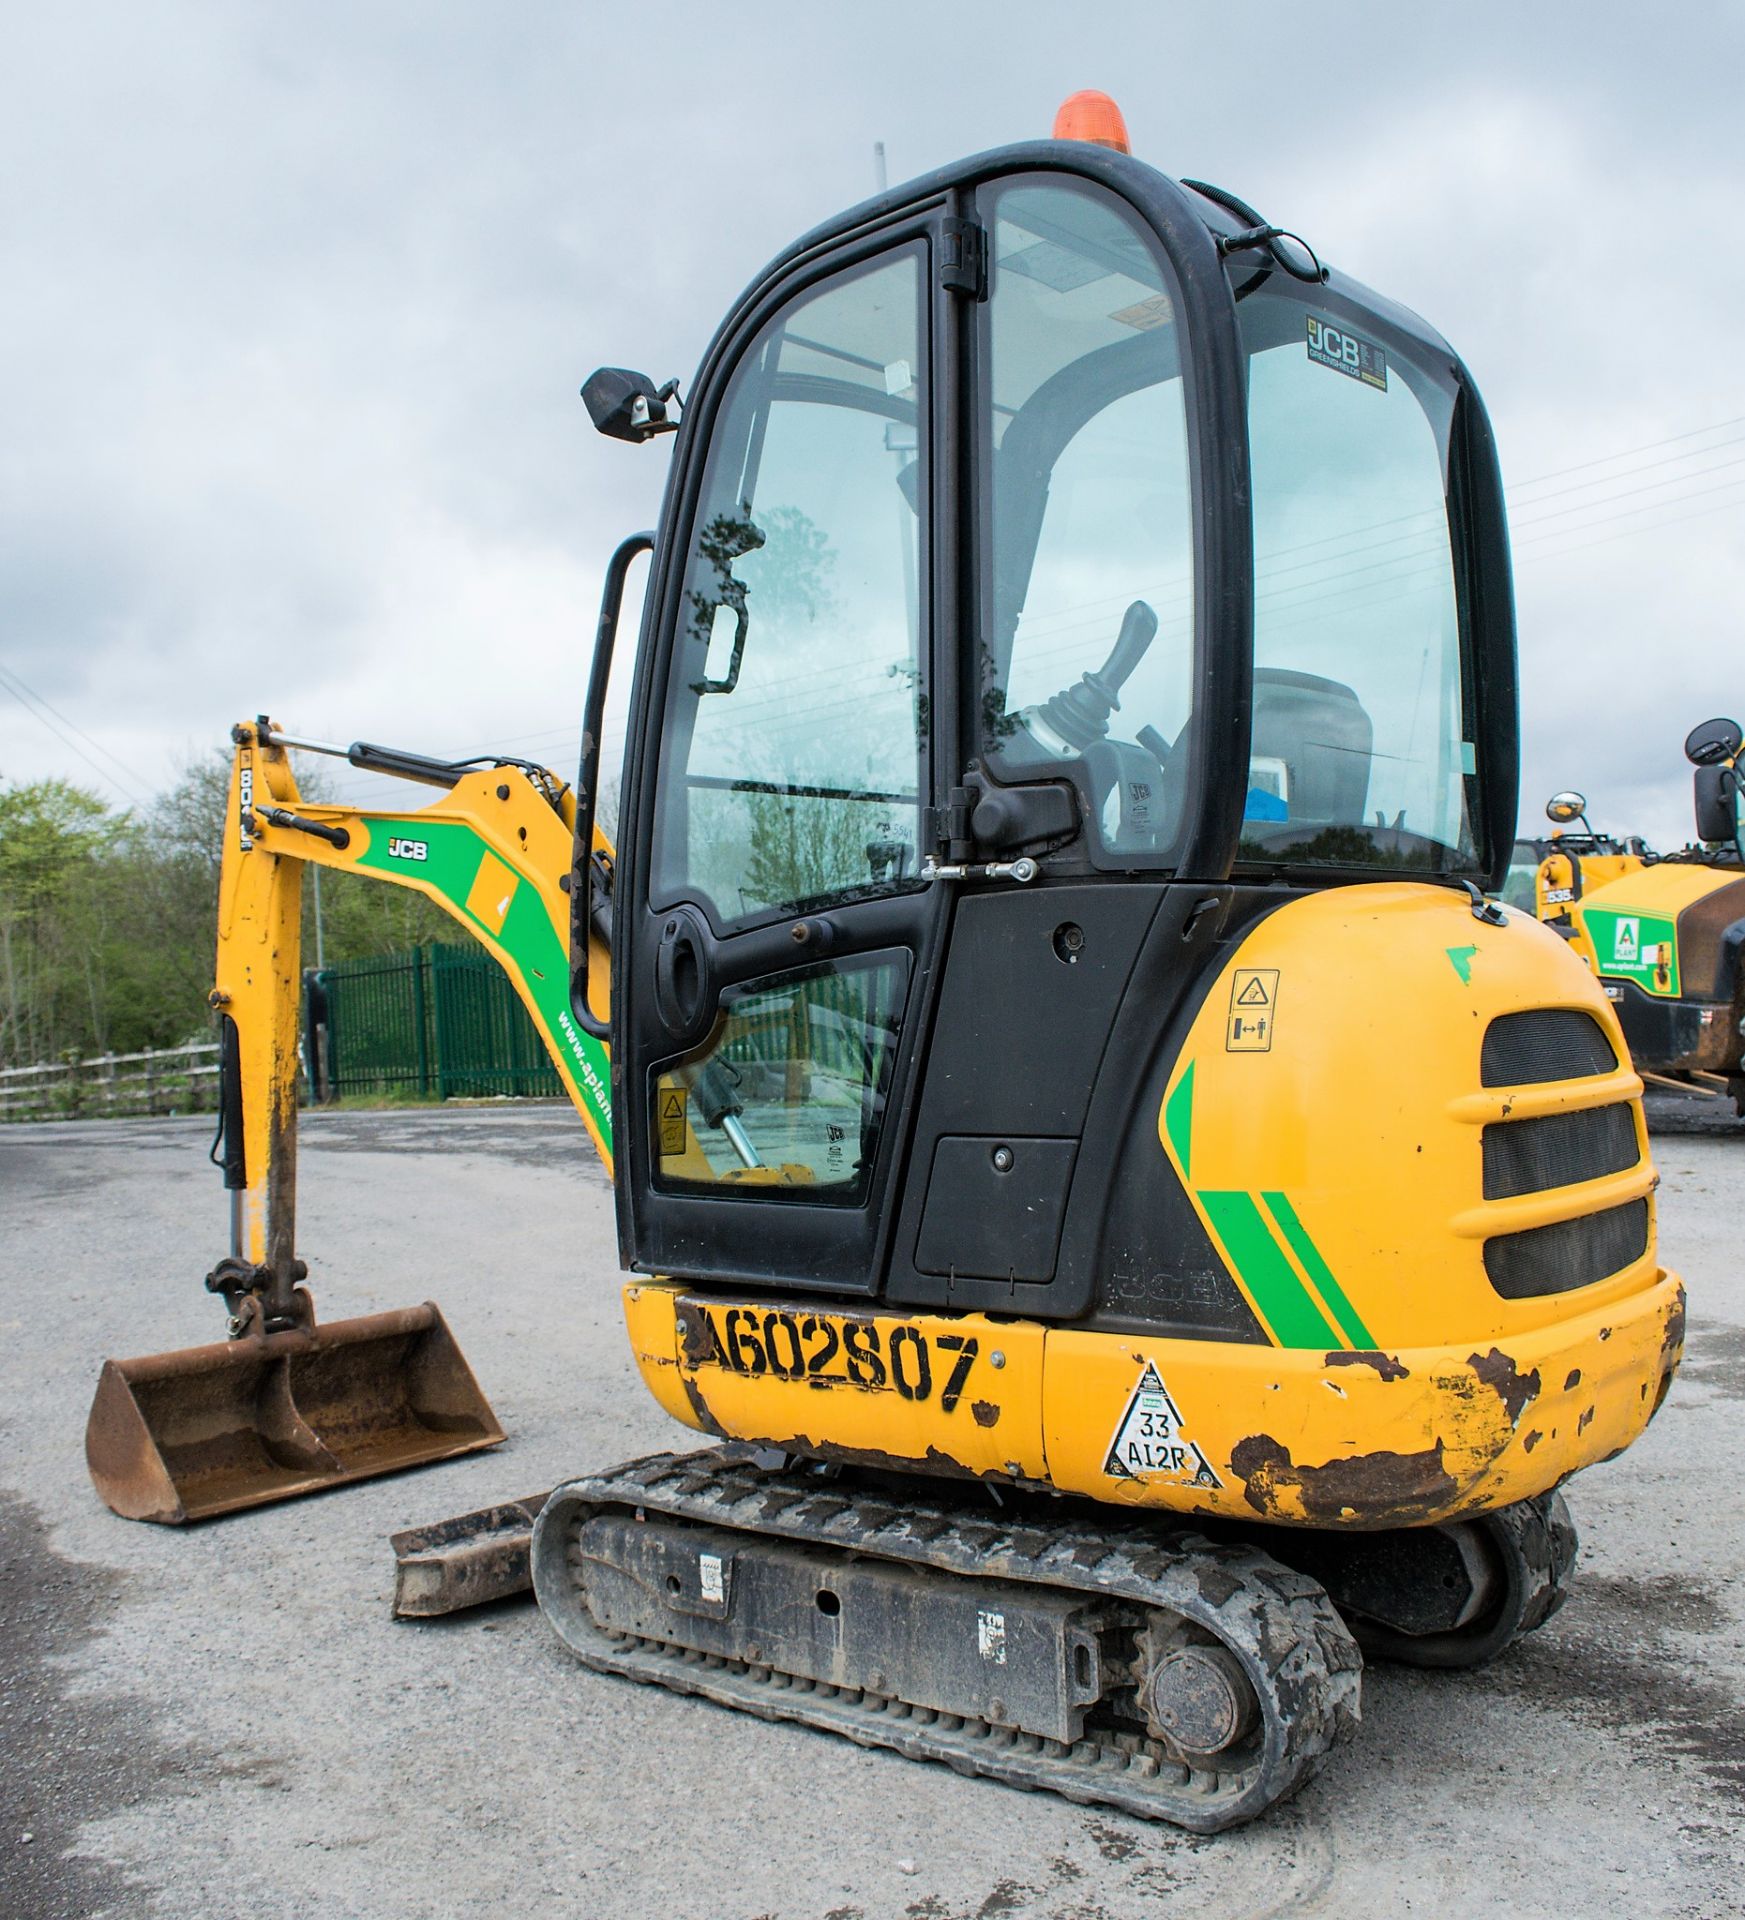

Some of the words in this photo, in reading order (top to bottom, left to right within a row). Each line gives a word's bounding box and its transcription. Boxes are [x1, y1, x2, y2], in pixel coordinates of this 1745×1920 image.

[1308, 322, 1360, 368] JCB
[389, 839, 427, 861] JCB
[1140, 1412, 1169, 1439] 33
